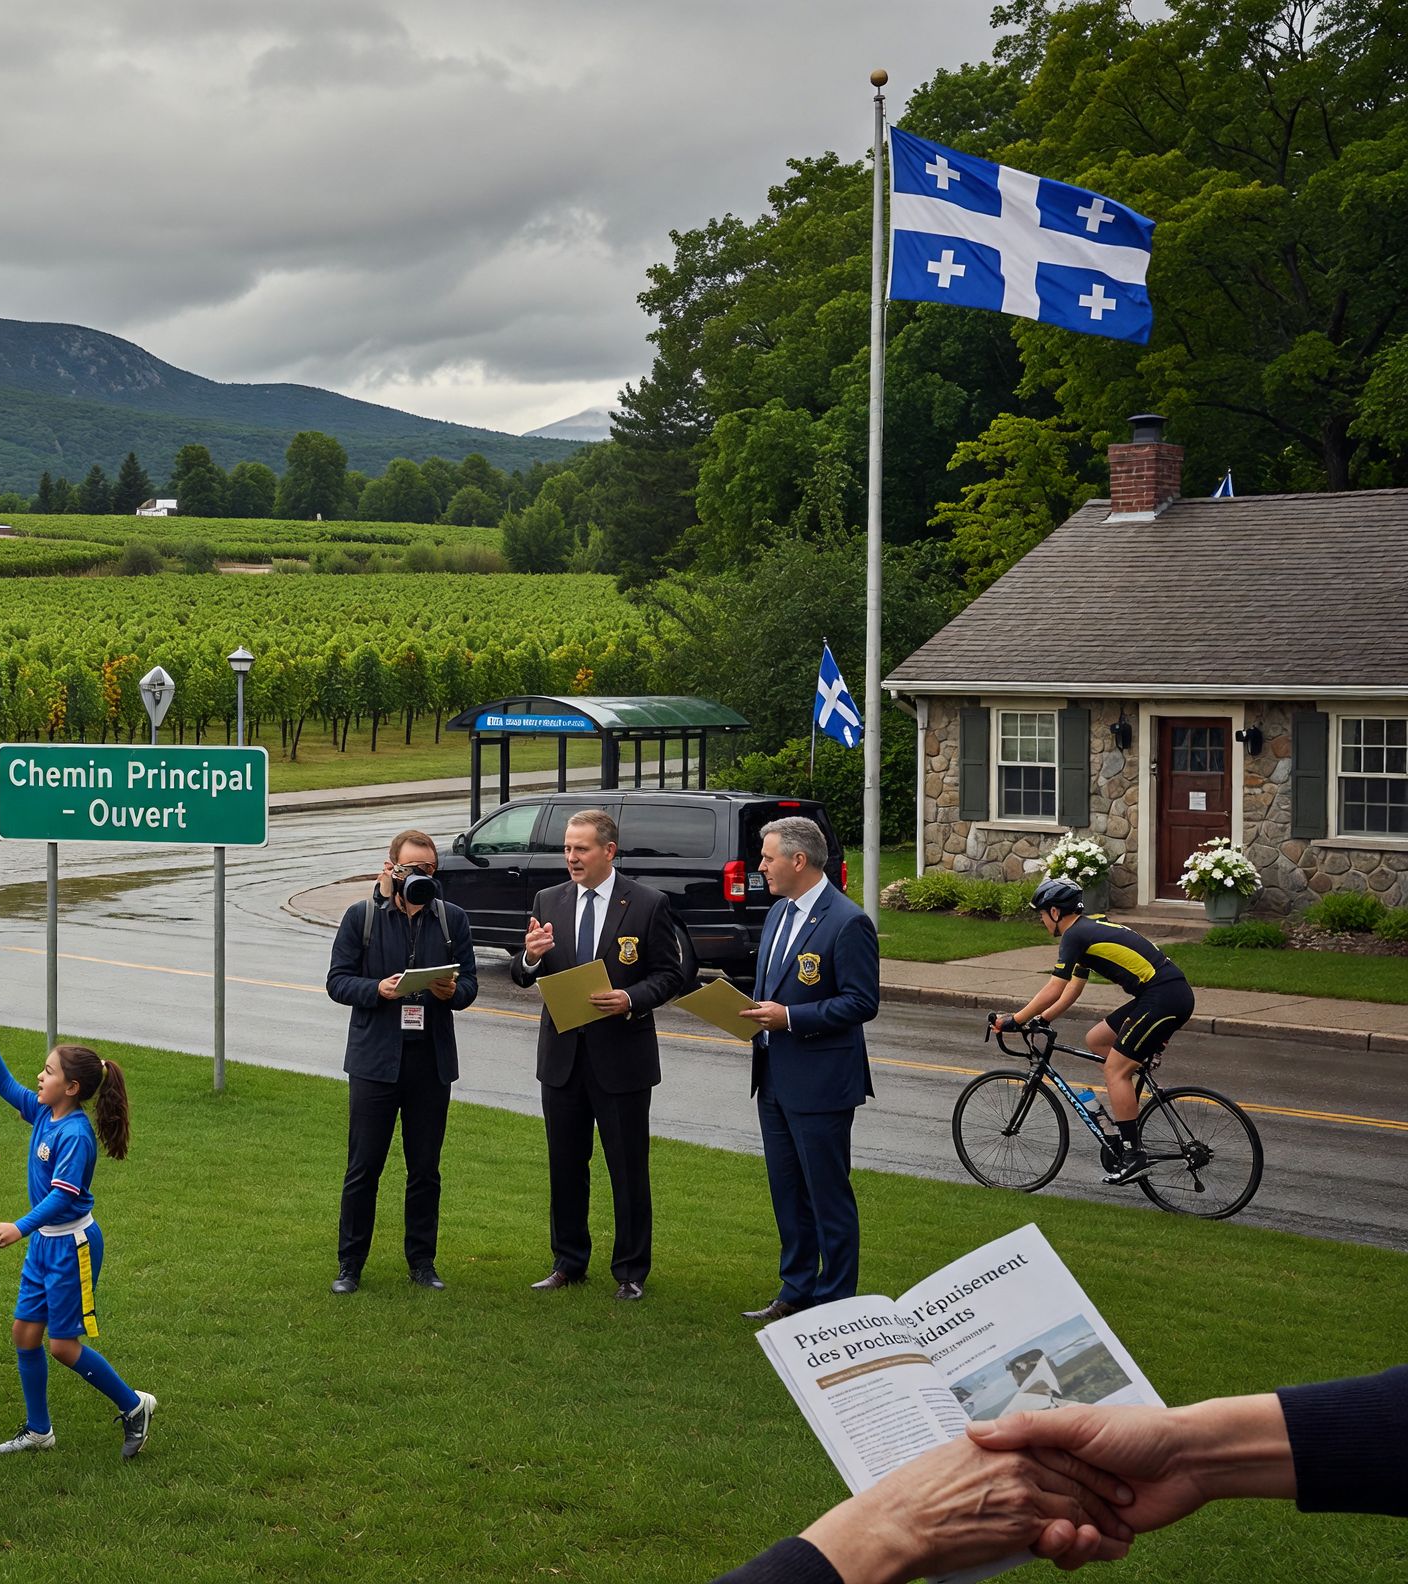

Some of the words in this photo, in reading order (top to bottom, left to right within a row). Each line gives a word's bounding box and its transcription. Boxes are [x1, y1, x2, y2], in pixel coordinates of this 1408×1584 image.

[9, 758, 113, 788] Chemin
[127, 761, 253, 797] Principal
[89, 798, 187, 829] Ouvert
[794, 1314, 893, 1349] Prévention
[913, 1253, 1029, 1322] l'épuisement
[807, 1349, 841, 1368] des
